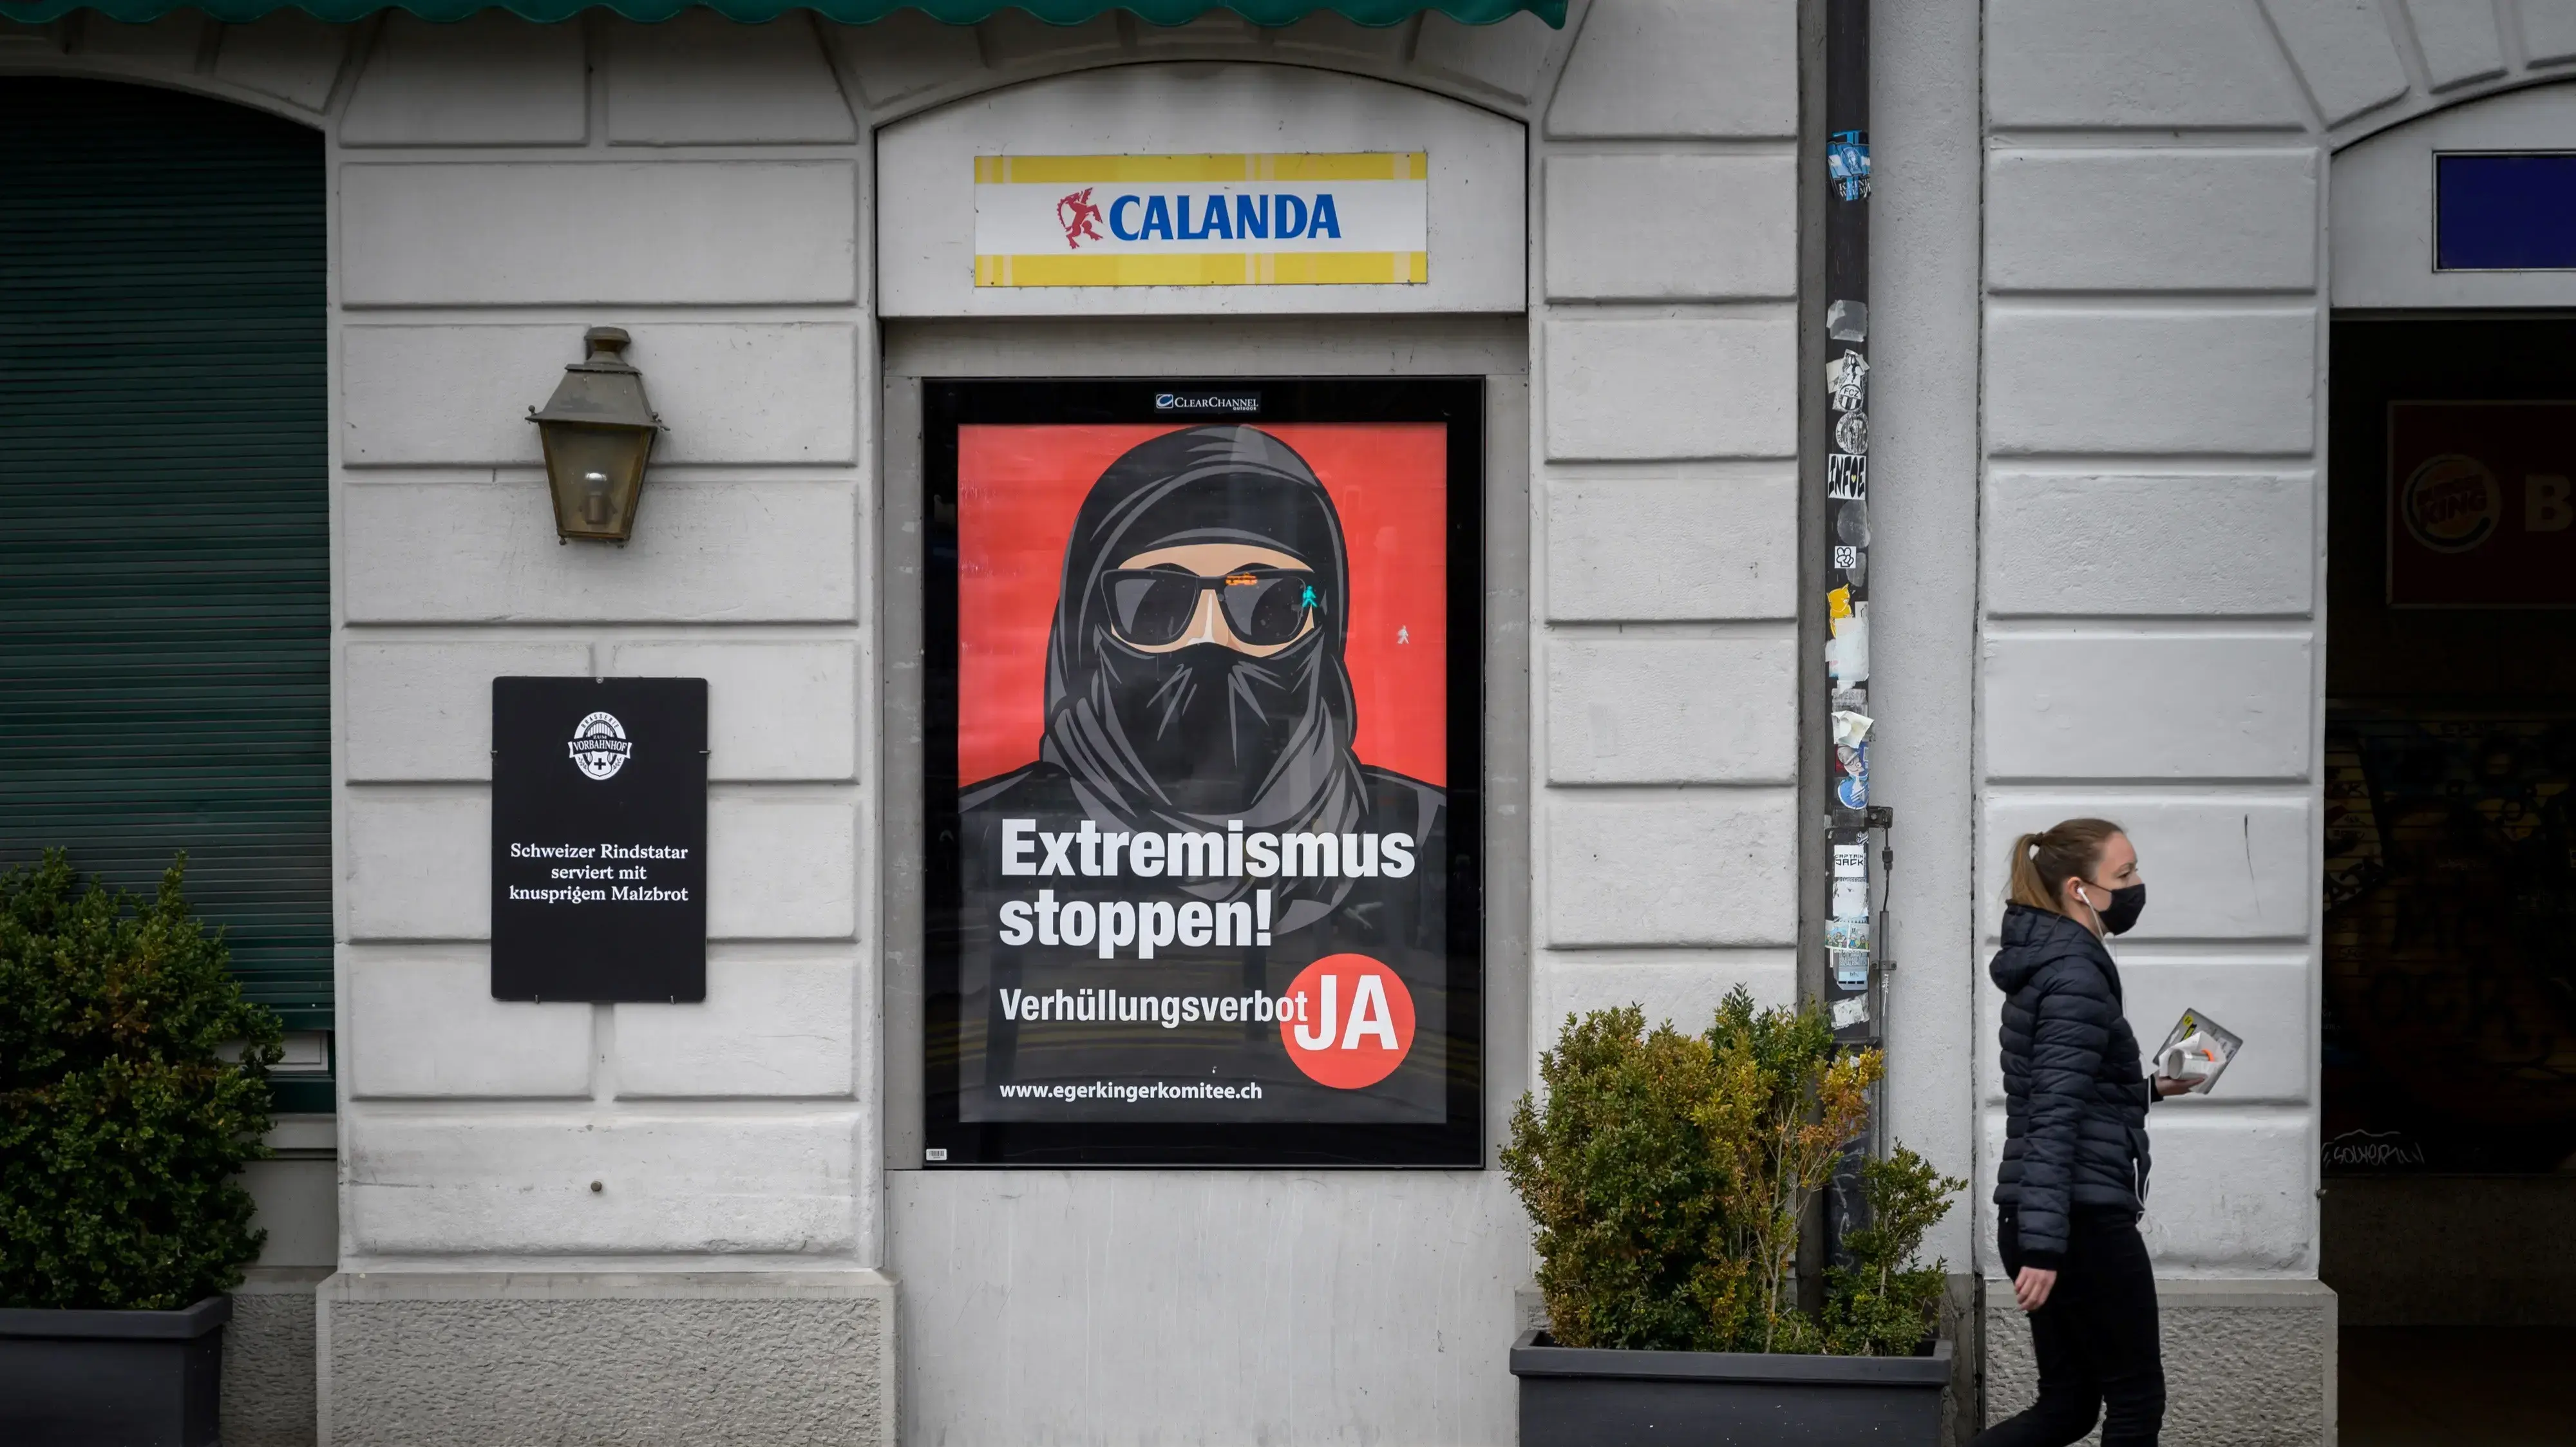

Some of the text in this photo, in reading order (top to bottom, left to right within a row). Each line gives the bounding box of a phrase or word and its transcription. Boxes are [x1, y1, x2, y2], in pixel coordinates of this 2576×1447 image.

[1109, 194, 1341, 241] CALANDA
[1844, 387, 1859, 398] FCZ
[581, 714, 619, 728] BRASSERIE
[573, 740, 627, 752] VORBAHNHOF
[511, 843, 688, 859] Schweizer Rindstatar
[1002, 819, 1416, 877] Extremismus
[551, 865, 647, 880] serviert mit
[509, 885, 688, 904] knusprigem Malzbrot
[999, 889, 1271, 959] stoppen!
[999, 974, 1399, 1051] Verhüllungsverbot JA
[999, 1082, 1262, 1102] www.egerkingerkomitee.ch
